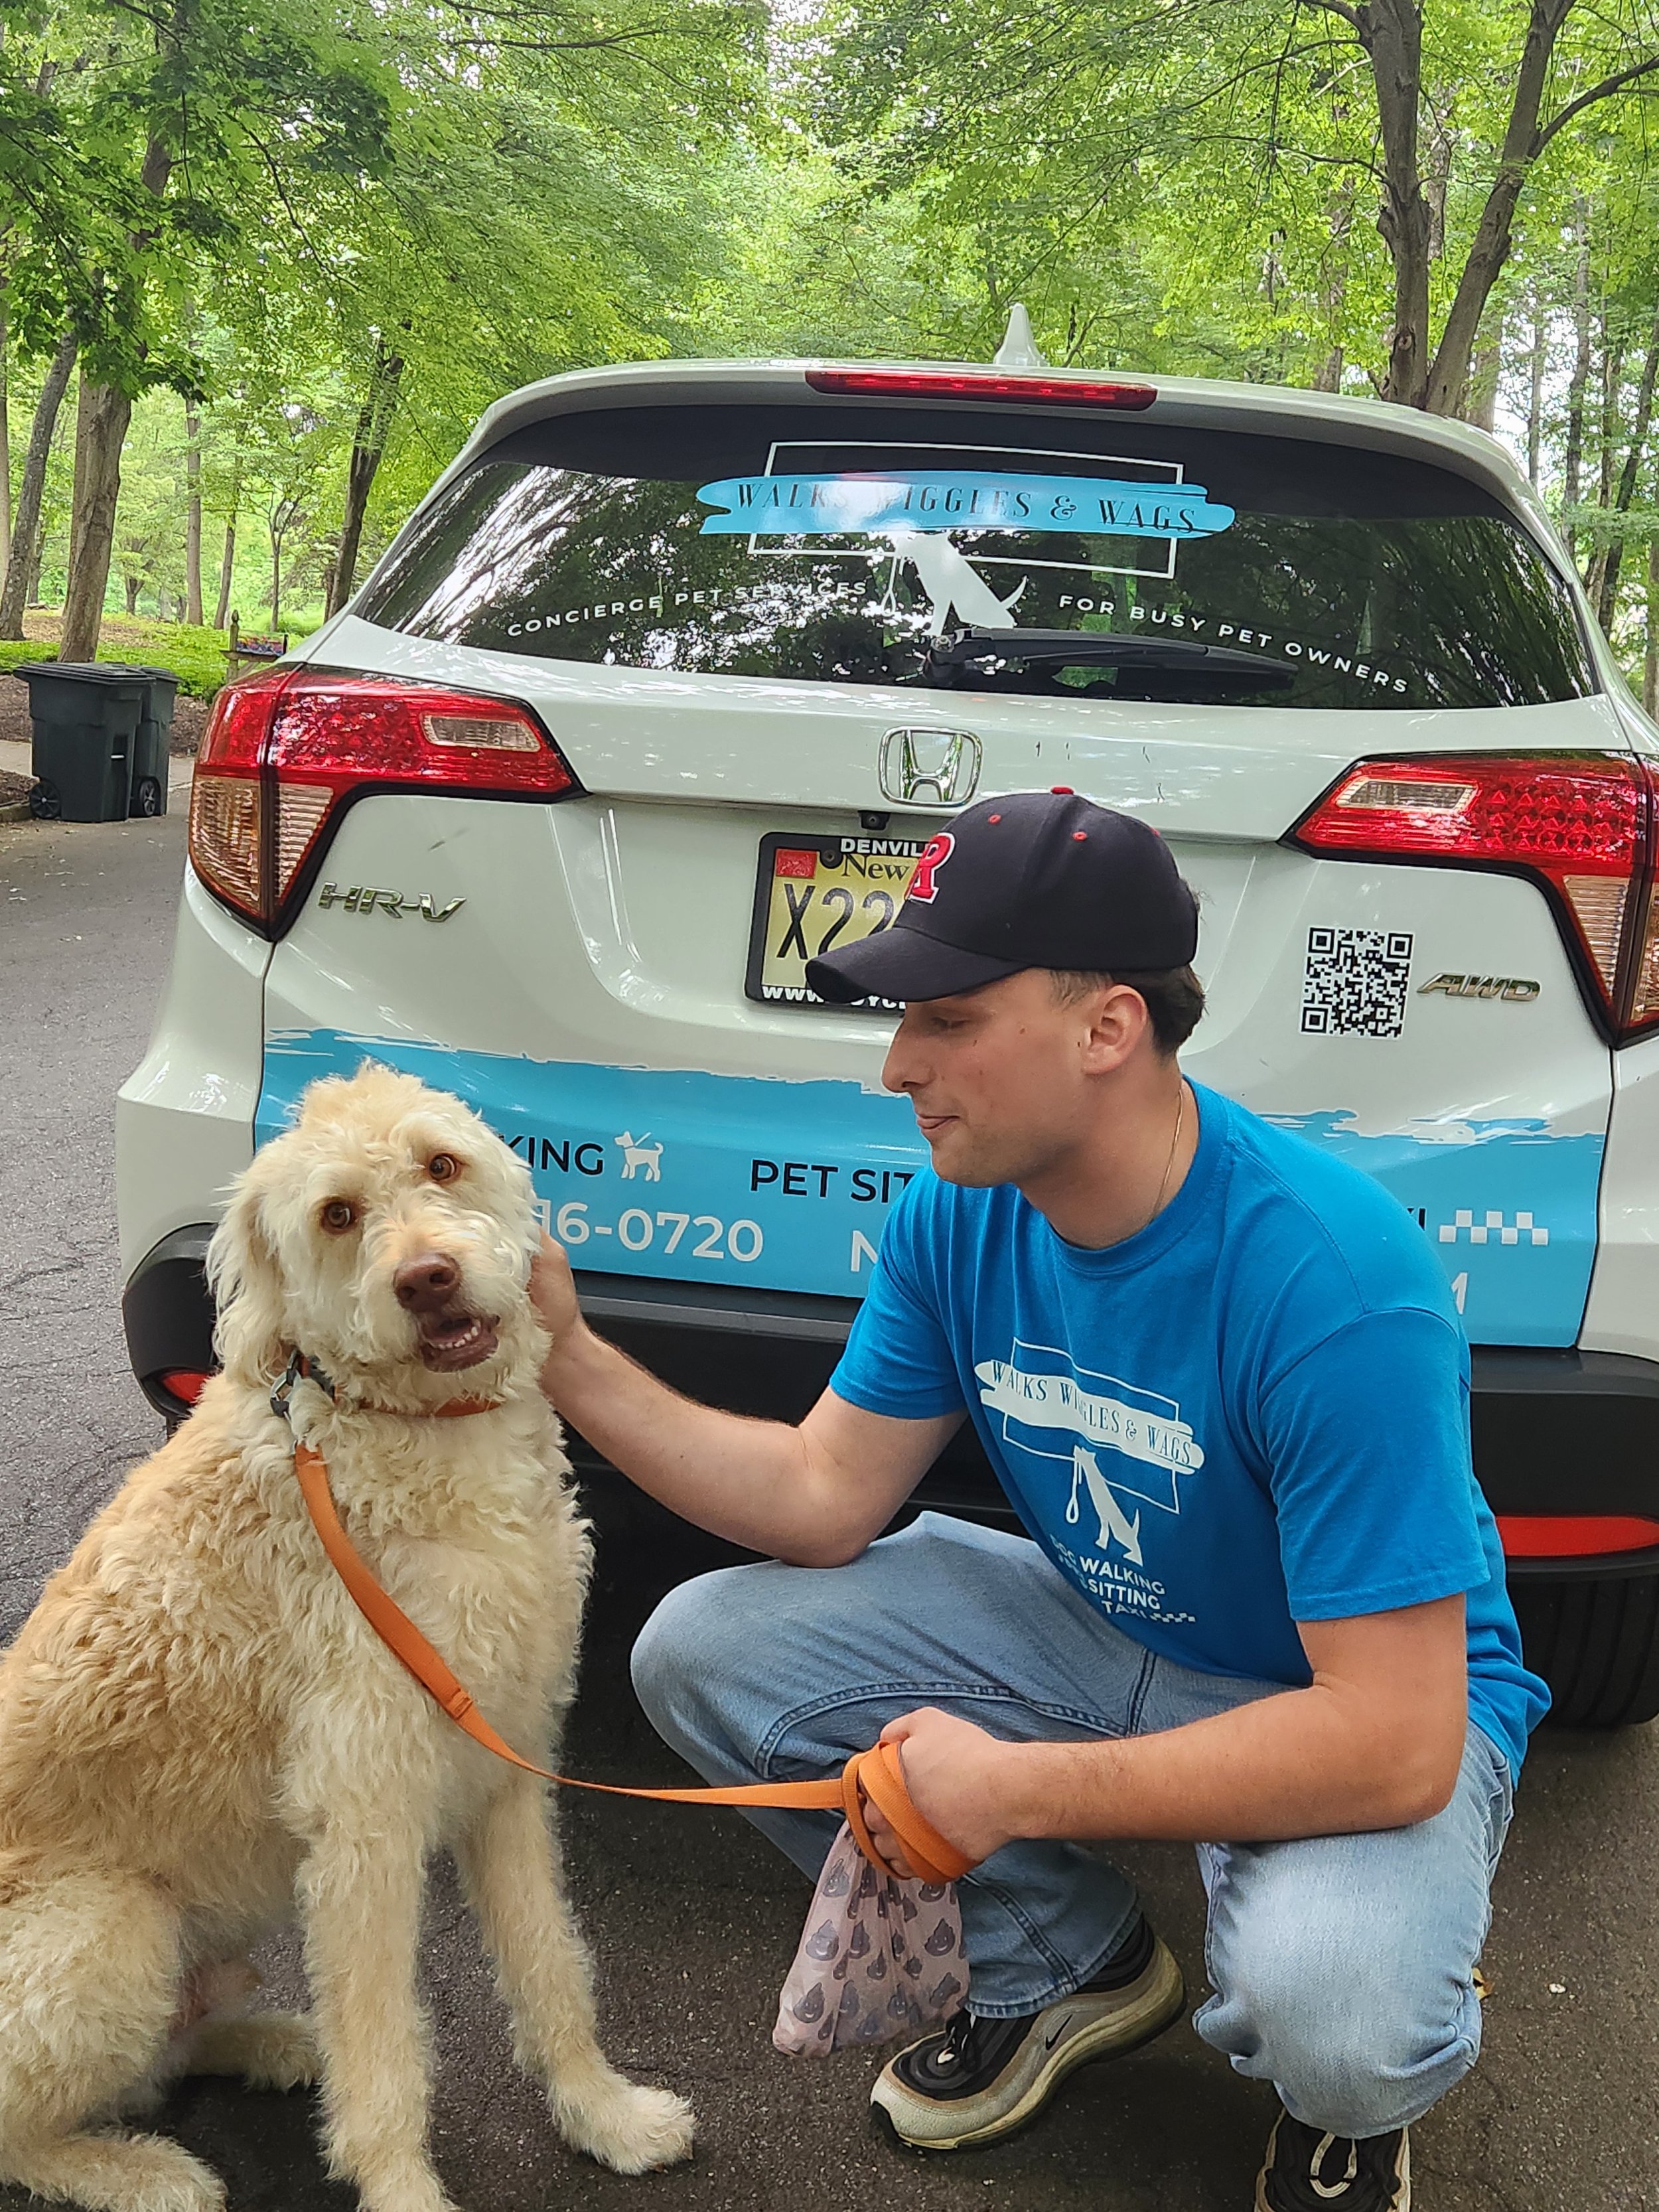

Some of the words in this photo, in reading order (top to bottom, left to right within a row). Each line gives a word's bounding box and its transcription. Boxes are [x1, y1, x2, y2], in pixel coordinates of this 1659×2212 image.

[876, 484, 1032, 519] IGGLES
[1051, 494, 1076, 522] &
[1098, 498, 1196, 534] WAGS
[507, 595, 662, 636] CONCIERGE
[674, 588, 723, 606] PET
[734, 581, 867, 599] SERVICES
[1059, 594, 1116, 616] FOR
[1129, 605, 1208, 632] BUSY
[1218, 624, 1274, 649] PET
[1284, 641, 1409, 694] OWNERS
[840, 838, 930, 857] DENVIL
[841, 853, 910, 882] New
[319, 882, 467, 923] HR-V
[1416, 972, 1542, 1002] AWD
[750, 1159, 839, 1199] PET
[993, 1361, 1047, 1402] WALKS
[1125, 1419, 1137, 1442] &
[1147, 1424, 1191, 1465] WAGS
[1079, 1556, 1166, 1595] WALKING
[1088, 1578, 1161, 1610] SITTING
[1101, 1600, 1148, 1619] TAXI
